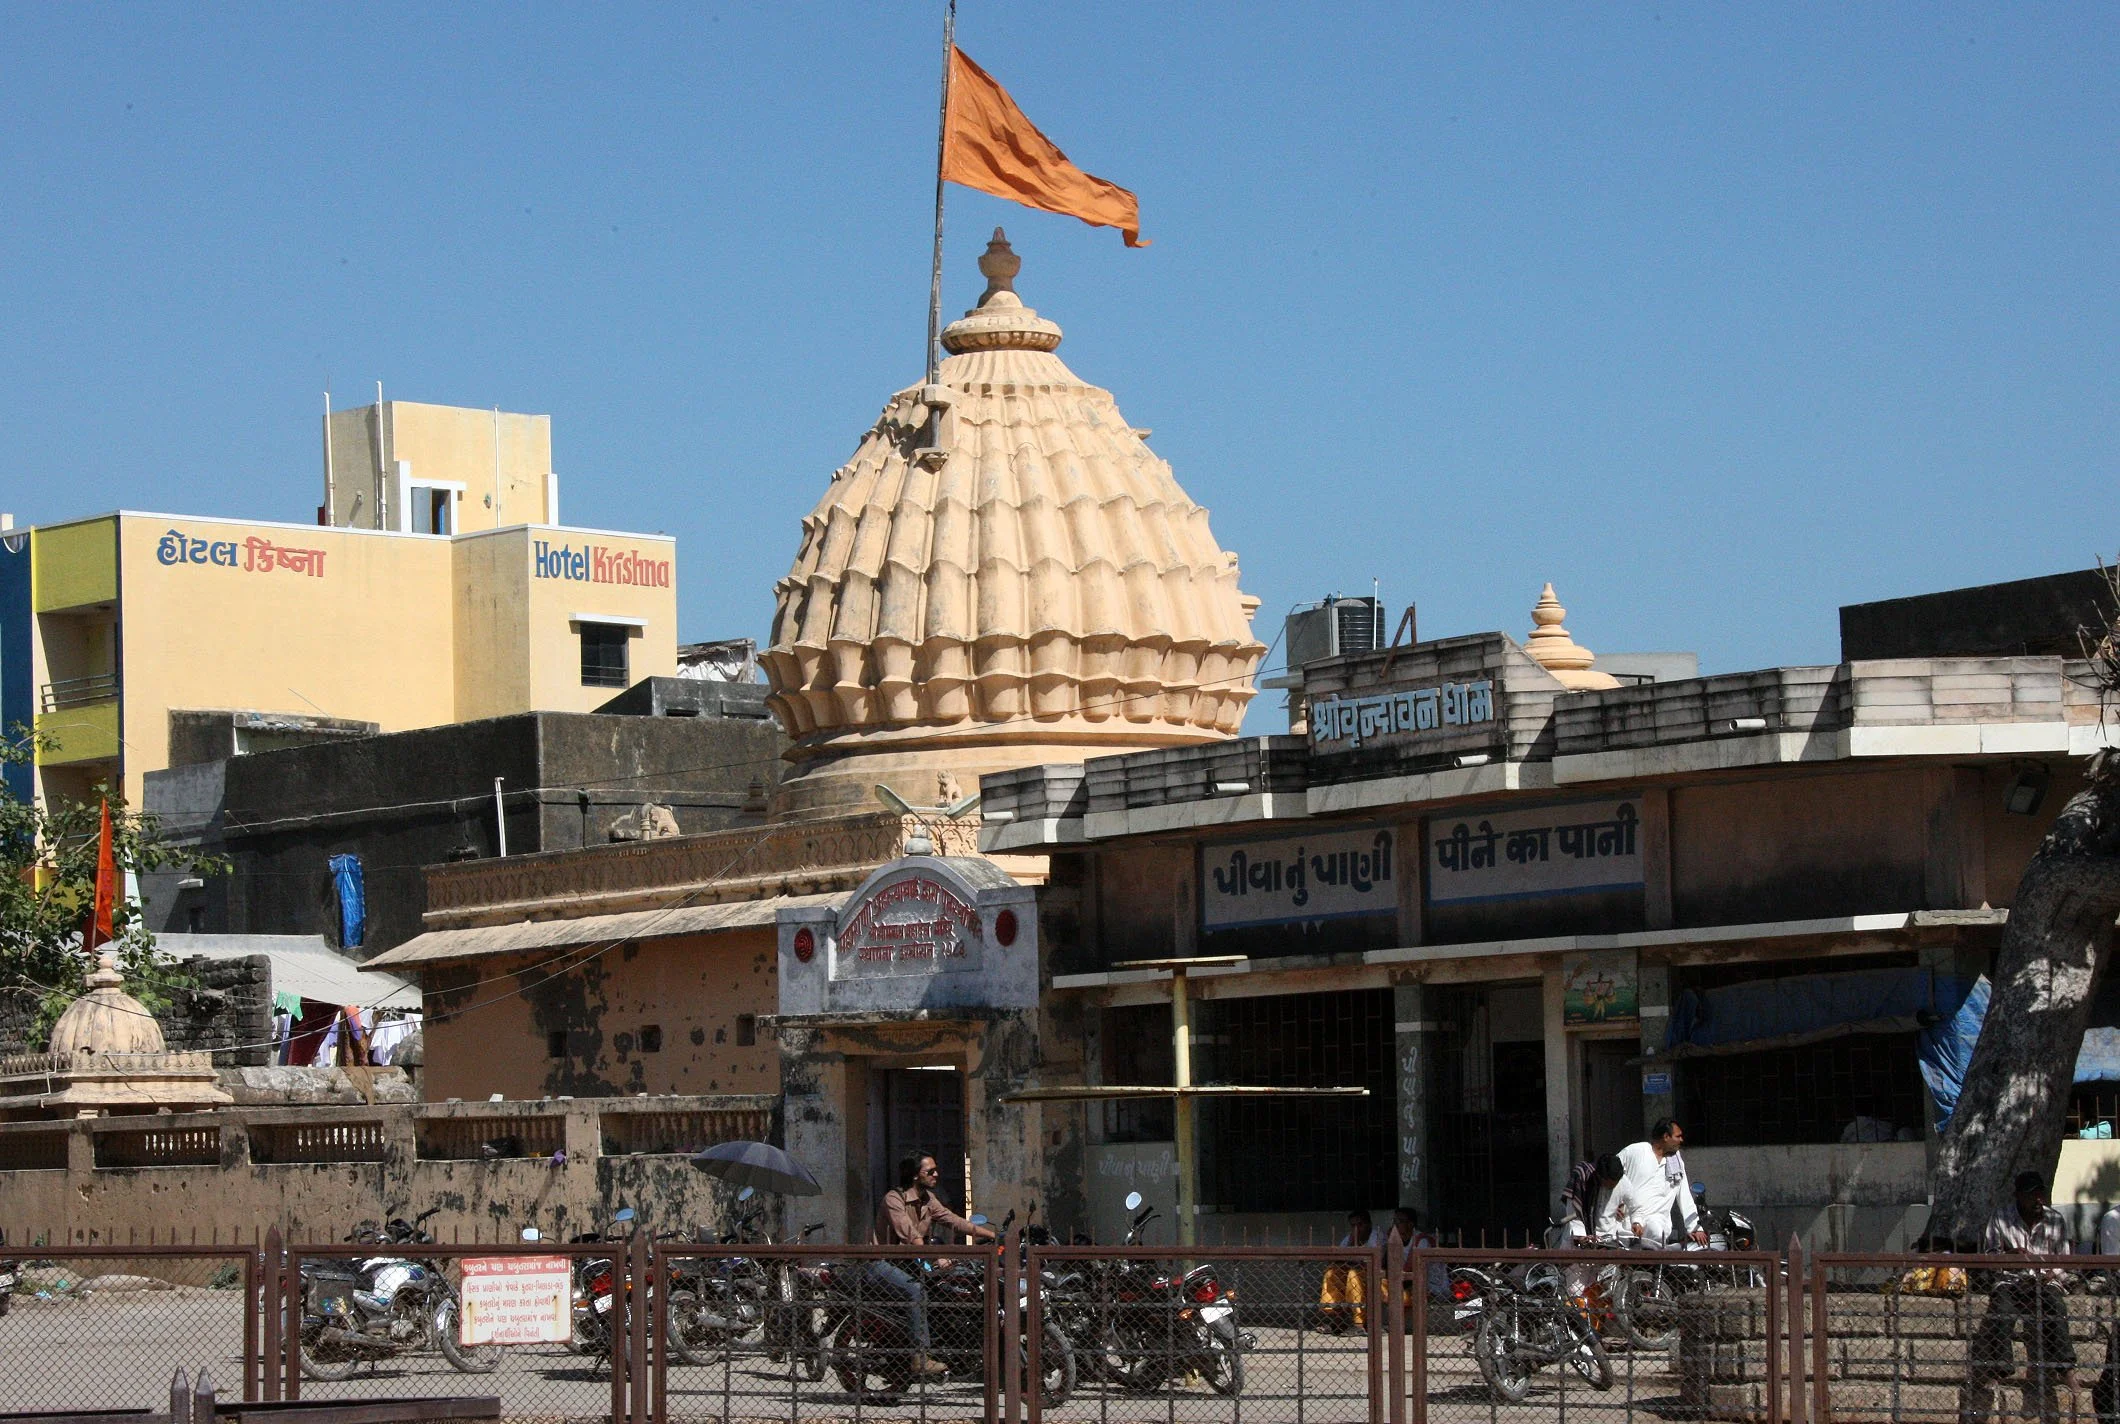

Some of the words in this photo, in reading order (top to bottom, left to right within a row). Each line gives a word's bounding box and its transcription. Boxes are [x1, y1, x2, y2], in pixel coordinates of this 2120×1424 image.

[533, 540, 590, 582] Hotel
[592, 546, 670, 588] Krishna
[1441, 680, 1494, 725] धाम
[1311, 830, 1393, 892] પાણી
[1435, 820, 1504, 872] पीने
[1506, 827, 1552, 864] का
[1555, 802, 1639, 858] पानी
